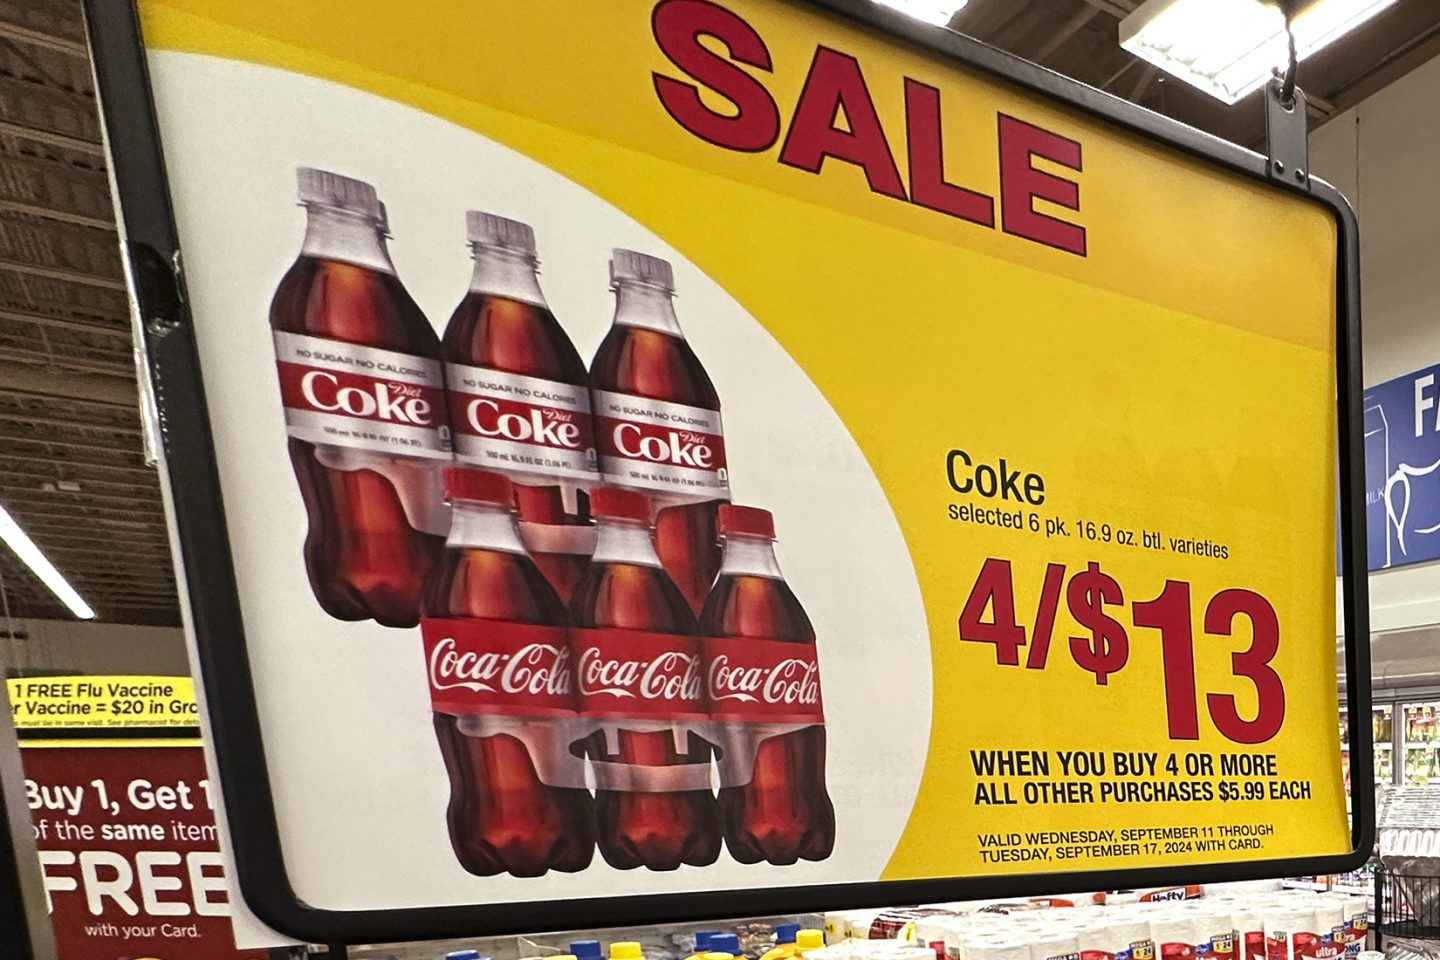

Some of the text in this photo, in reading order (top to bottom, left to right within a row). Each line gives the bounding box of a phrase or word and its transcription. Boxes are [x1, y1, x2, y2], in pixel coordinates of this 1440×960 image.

[651, 0, 1087, 257] SALE
[296, 349, 311, 358] NO
[313, 351, 353, 366] SUGAR
[356, 359, 375, 370] NO
[302, 371, 431, 425] Diet Coke
[463, 379, 477, 388] NO
[478, 380, 513, 394] SUGAR
[515, 387, 531, 396] NO
[467, 399, 581, 448] Diet Coke
[610, 405, 622, 413] NO
[623, 405, 653, 417] SUGAR
[655, 411, 669, 420] NO
[613, 423, 713, 468] Diet Coke
[946, 449, 1046, 505] Coke
[948, 503, 1229, 559] selected 6 pk. 16.9 oz. btl. varieties
[430, 637, 571, 695] Coca-Cola
[958, 557, 1285, 744] 4/$13
[578, 647, 701, 701] Coca-Cola
[708, 655, 818, 705] Coca-Cola
[15, 683, 173, 698] 1 FREE Flu Vaccine
[25, 700, 91, 715] Vaccine
[111, 700, 144, 716] $20
[149, 700, 163, 714] in
[970, 750, 1278, 777] WHEN YOU BUY 4 OR MORE
[25, 779, 214, 817] Buy 1, Get 1
[974, 780, 1311, 805] ALL OTHER PURCHASES $5.99 EACH
[32, 820, 51, 841] of
[55, 820, 94, 841] the
[101, 822, 165, 841] same
[978, 824, 1274, 847] VALID WEDNESDAY, SEPTEMBER 11 THROUGH
[980, 838, 1264, 864] TUESDAY, SEPTEMBER 17, 2024 WITH CARD.
[38, 850, 232, 917] FREE
[84, 922, 202, 940] with your Card.
[1315, 946, 1338, 958] ultra
